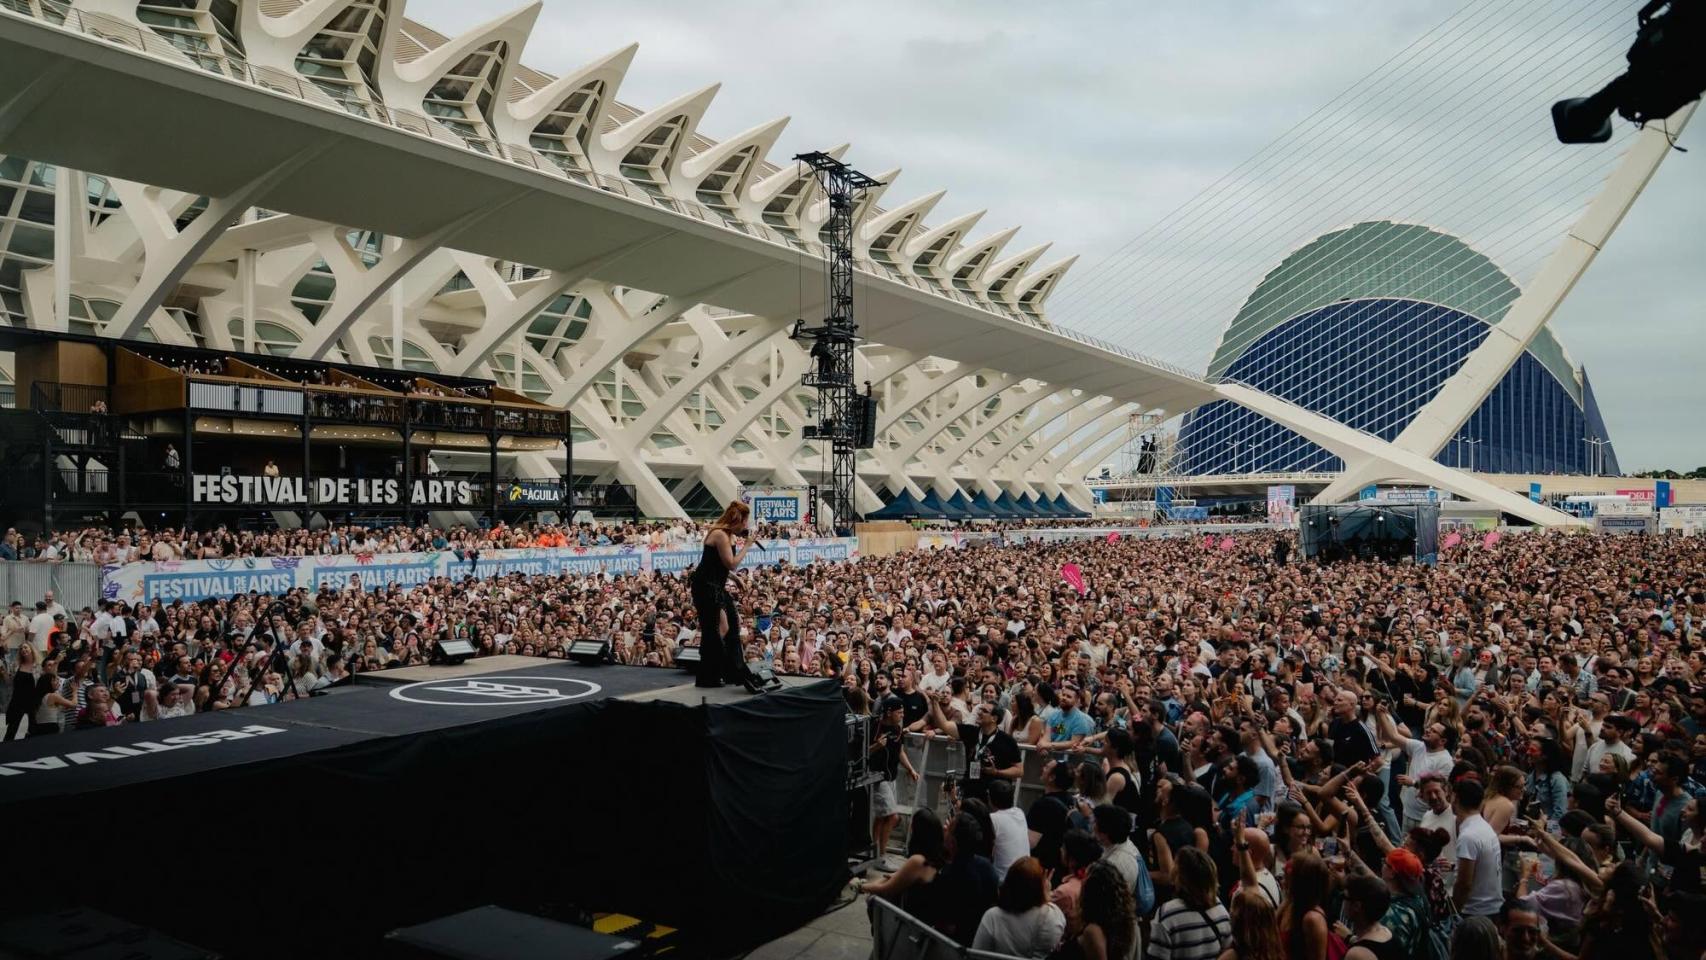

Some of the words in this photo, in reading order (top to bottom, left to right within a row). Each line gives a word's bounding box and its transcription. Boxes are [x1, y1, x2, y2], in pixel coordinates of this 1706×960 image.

[193, 475, 307, 502] FESTIVAL
[319, 478, 349, 503] DE
[358, 479, 398, 504] LES
[411, 479, 470, 504] ARTS
[756, 499, 785, 508] FESTIVAL
[786, 499, 796, 508] DE
[772, 508, 796, 518] ARTS
[150, 576, 233, 599] FESTIVAL
[249, 573, 291, 593] ARTS
